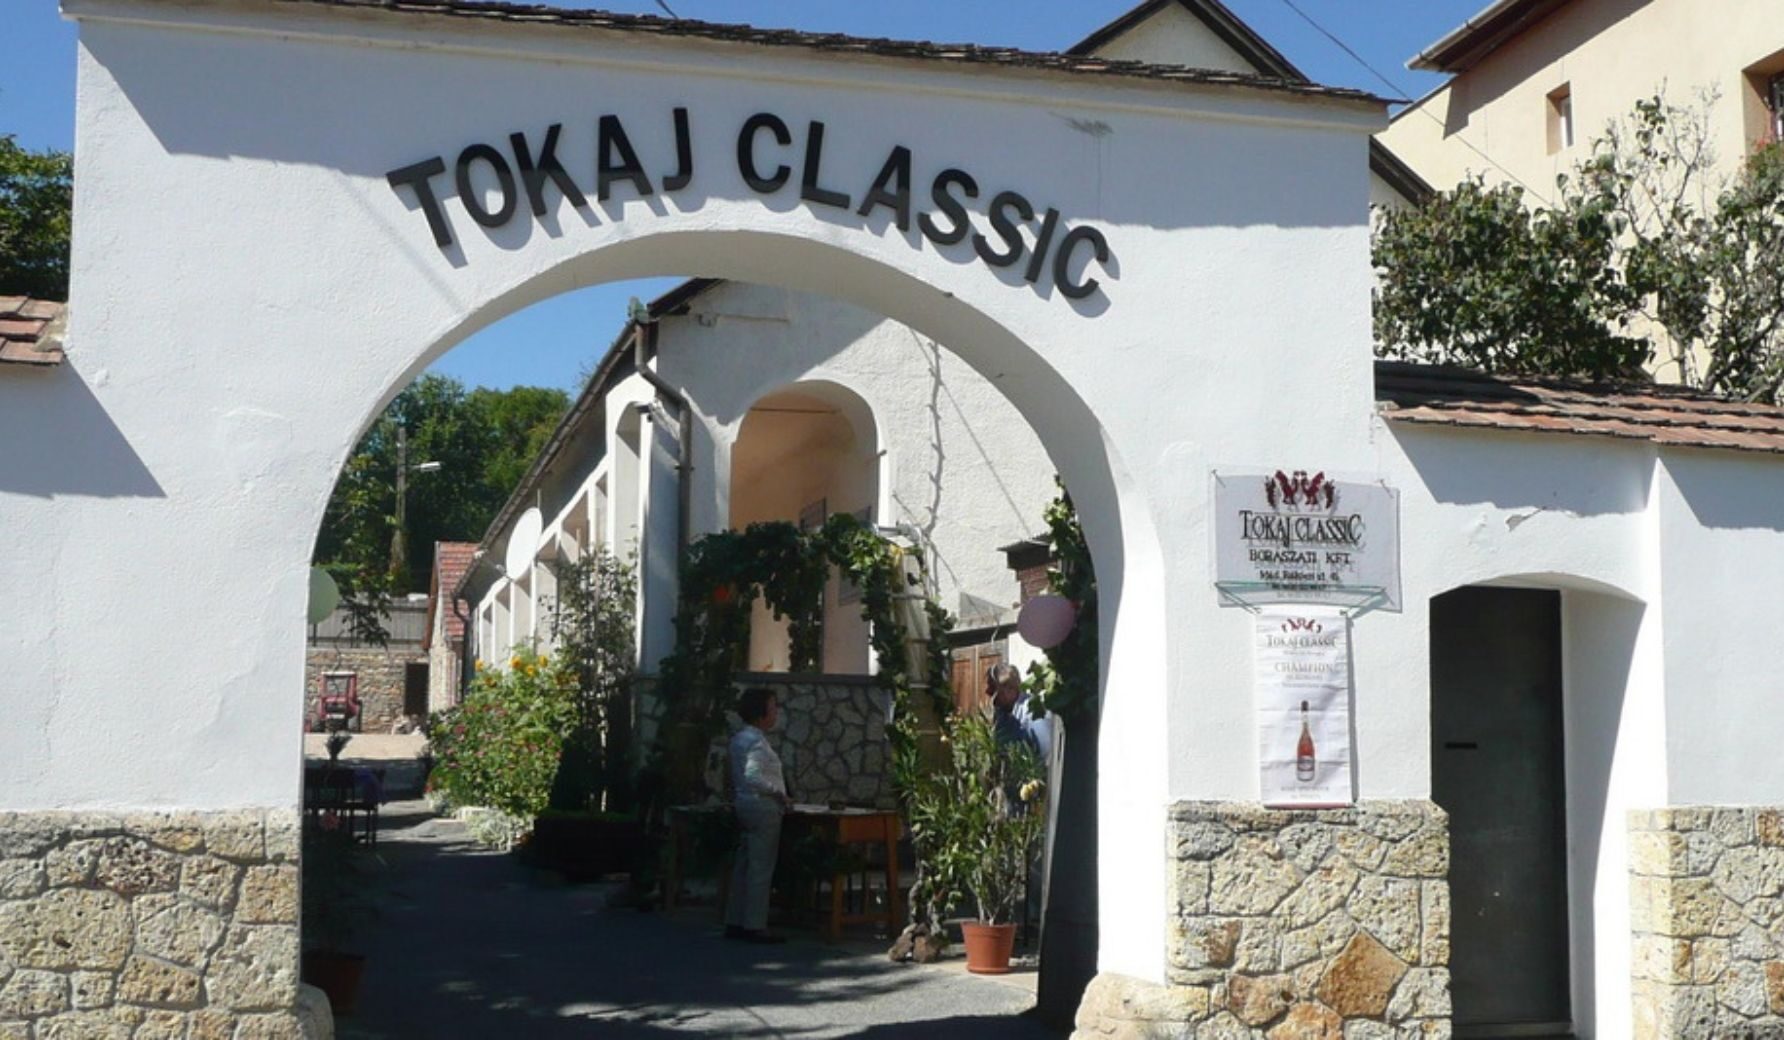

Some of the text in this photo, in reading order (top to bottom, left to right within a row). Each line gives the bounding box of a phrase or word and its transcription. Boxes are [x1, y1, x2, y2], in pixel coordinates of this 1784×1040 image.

[387, 107, 1110, 300] TOKAJ CLASSIC
[1239, 509, 1363, 548] TOKAJ CLASSIC
